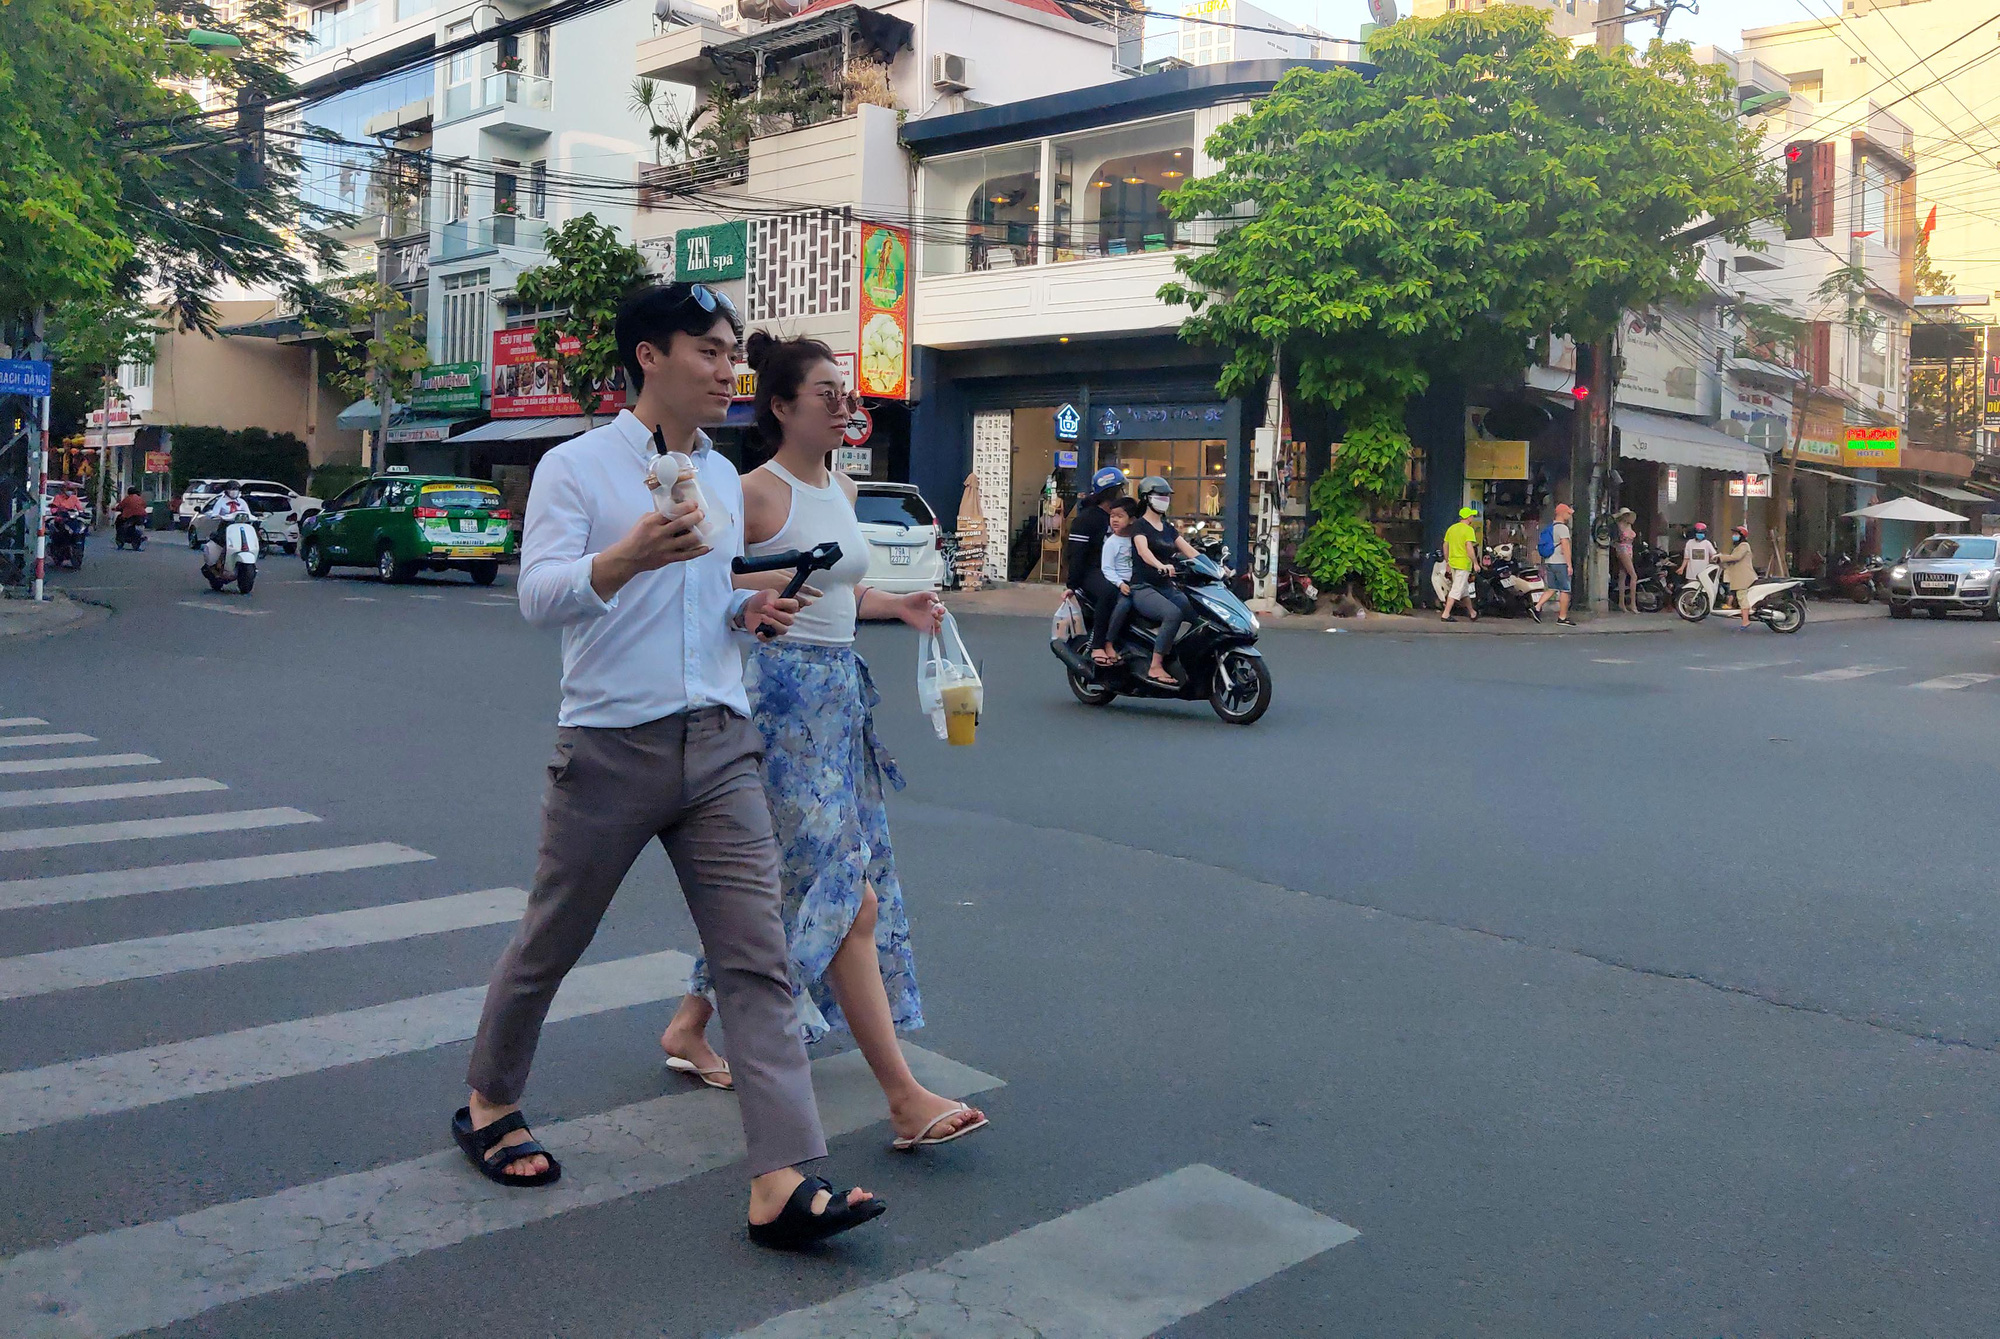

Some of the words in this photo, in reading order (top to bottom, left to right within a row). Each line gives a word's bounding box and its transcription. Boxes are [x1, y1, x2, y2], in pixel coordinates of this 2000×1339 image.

[687, 236, 710, 271] ZEN
[713, 254, 734, 272] spa
[1847, 429, 1898, 440] PELICAN
[955, 530, 982, 538] WELCOME
